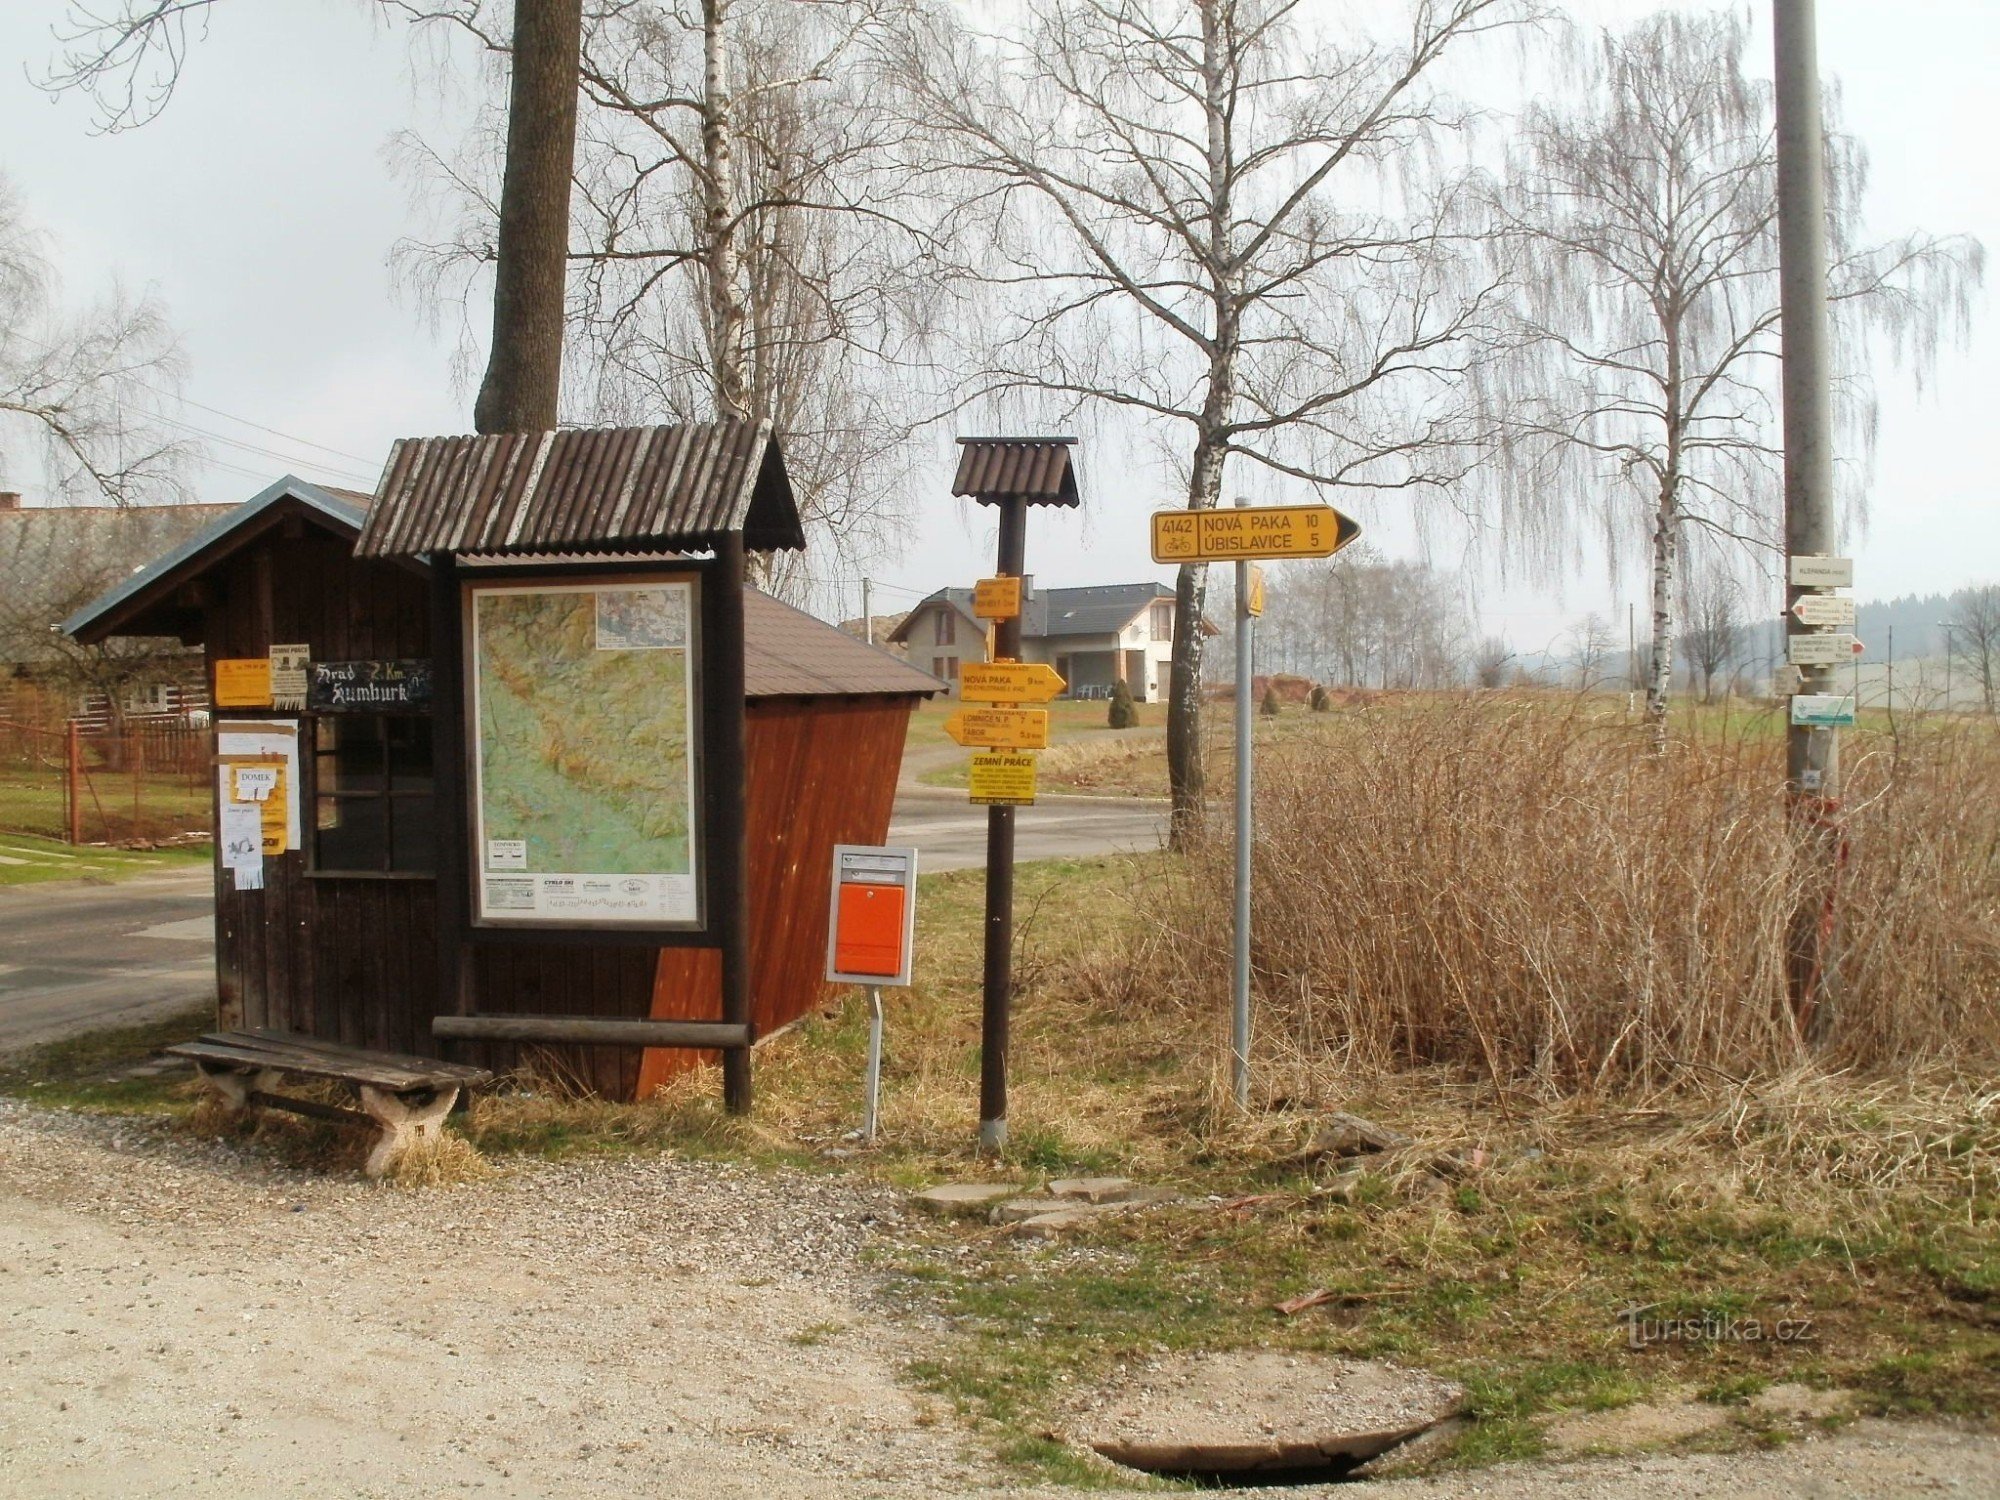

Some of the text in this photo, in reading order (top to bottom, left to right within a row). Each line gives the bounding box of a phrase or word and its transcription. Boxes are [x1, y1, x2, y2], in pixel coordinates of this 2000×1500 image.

[1162, 519, 1193, 534] 4142
[1204, 513, 1319, 532] NOVÁ PAKA 10
[1204, 533, 1319, 551] ÚBISLAVICE 5
[964, 673, 987, 684] NOVÁ
[989, 676, 1012, 684] PAKA
[973, 755, 1033, 767] ZEMNÍ PRÁCE
[241, 773, 271, 782] DOMEK
